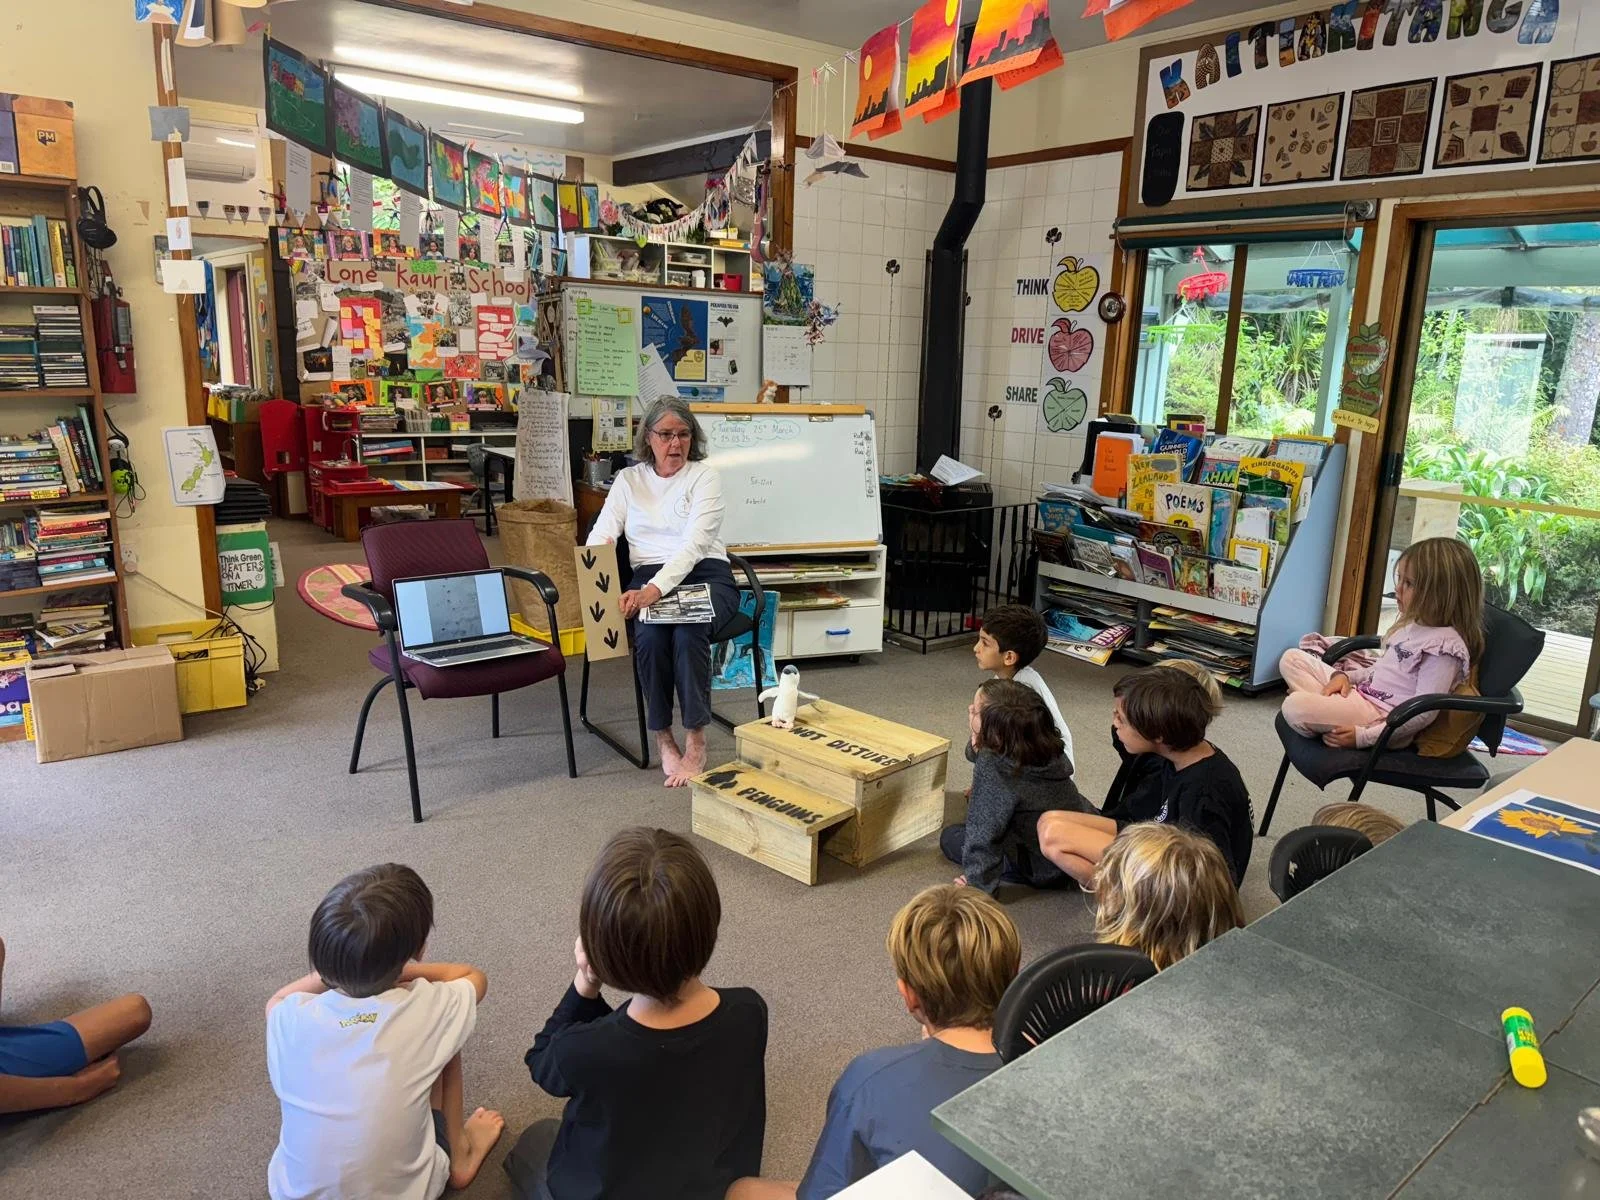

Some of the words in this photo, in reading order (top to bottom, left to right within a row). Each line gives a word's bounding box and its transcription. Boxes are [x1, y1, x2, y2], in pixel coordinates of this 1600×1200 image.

[1159, 0, 1559, 110] KAITIAKITANGA
[38, 131, 55, 140] PM
[325, 261, 378, 284] Lone
[397, 265, 448, 290] Kauri
[468, 270, 531, 297] School
[1016, 278, 1050, 296] THINK
[1011, 327, 1045, 344] DRIVE
[1005, 386, 1038, 403] SHARE
[719, 422, 745, 433] Tuesday
[1250, 460, 1300, 480] KINDERGARTEN
[1165, 493, 1205, 513] POEMS
[219, 554, 239, 564] Think
[240, 553, 262, 562] Green
[221, 560, 264, 573] HEATERS
[235, 572, 241, 580] A
[788, 726, 827, 741] NOT
[826, 739, 900, 766] DISTURB
[736, 787, 823, 824] PENGUINS
